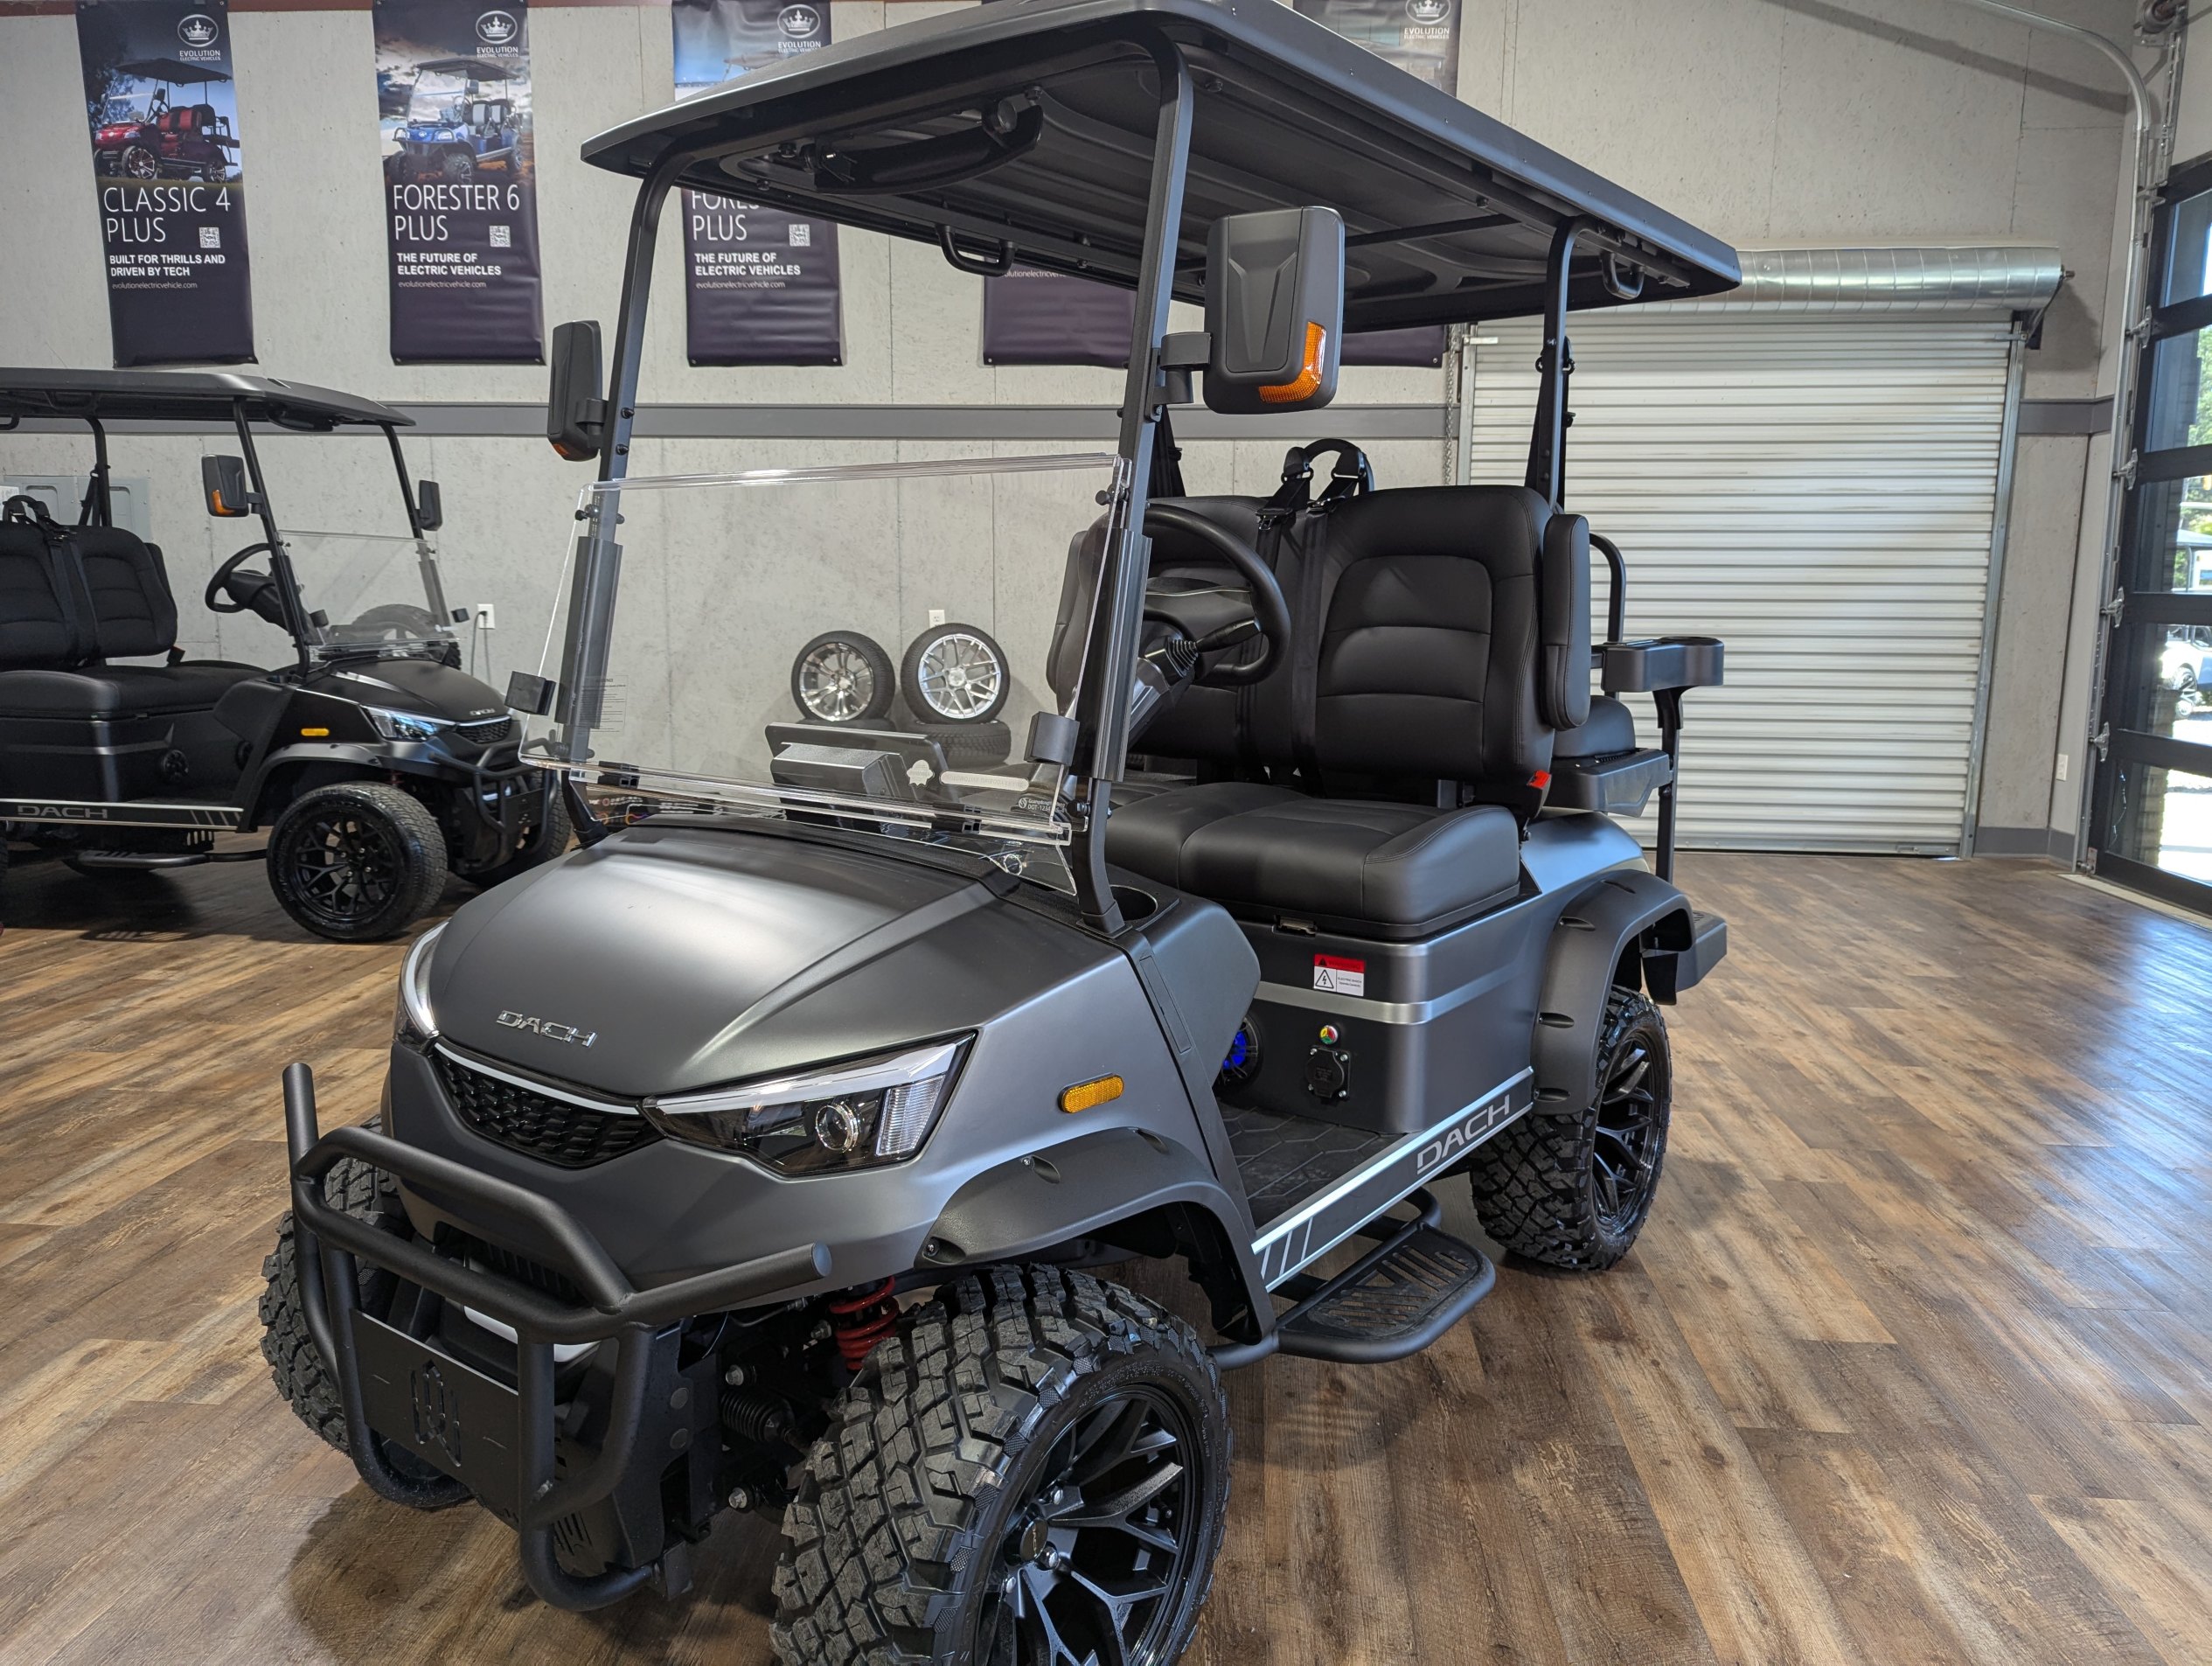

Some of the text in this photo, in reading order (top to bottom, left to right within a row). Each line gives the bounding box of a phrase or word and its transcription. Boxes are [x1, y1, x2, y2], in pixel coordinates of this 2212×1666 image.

[778, 40, 821, 49] EVOLUTION
[103, 186, 231, 213] CLASSIC 4
[393, 184, 520, 211] FORESTER 6
[106, 217, 166, 243] PLUS
[394, 215, 449, 241] PLUS
[692, 214, 748, 241] PLUS
[109, 254, 226, 265] BUILT FOR THRILLS AND
[397, 253, 478, 263] THE FUTURE OF
[694, 252, 777, 263] THE FUTURE OF
[110, 267, 191, 277] DRIVEN BY TECH
[397, 265, 502, 275] ELECTRIC VEHICLES
[695, 264, 801, 275] ELECTRIC VEHICLES
[17, 805, 108, 819] DACH
[496, 1009, 597, 1047] DACH
[1416, 1094, 1510, 1175] DACH
